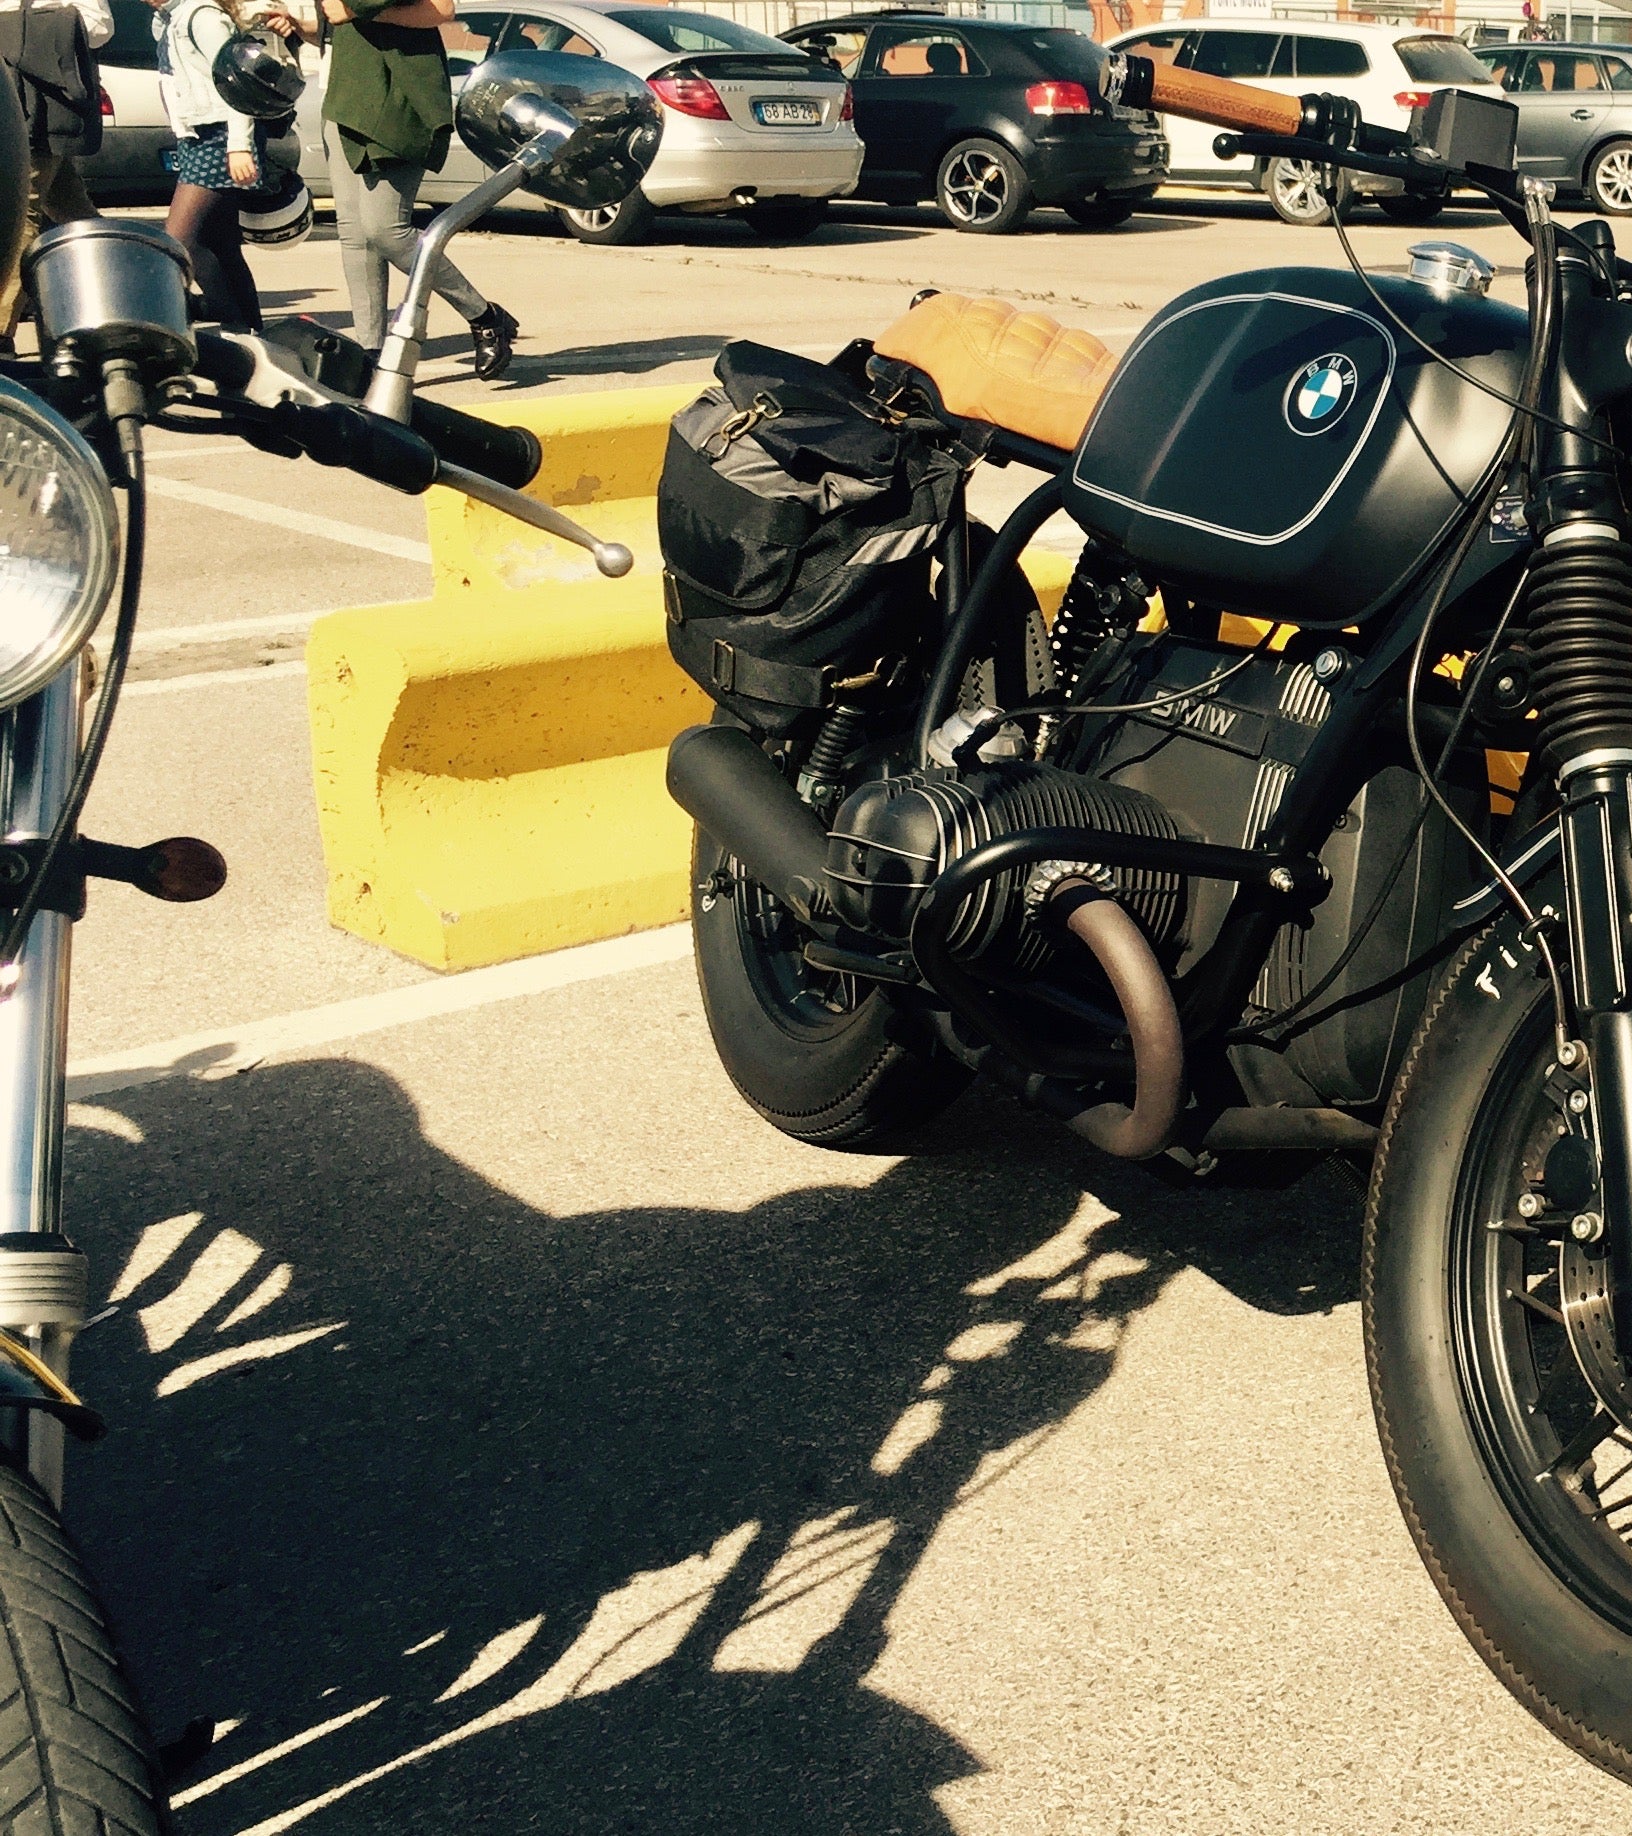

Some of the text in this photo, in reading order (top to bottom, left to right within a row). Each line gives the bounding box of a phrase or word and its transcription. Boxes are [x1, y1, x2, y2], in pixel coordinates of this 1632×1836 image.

[764, 103, 780, 119] 68
[783, 103, 799, 119] AB
[1306, 356, 1355, 386] BMW
